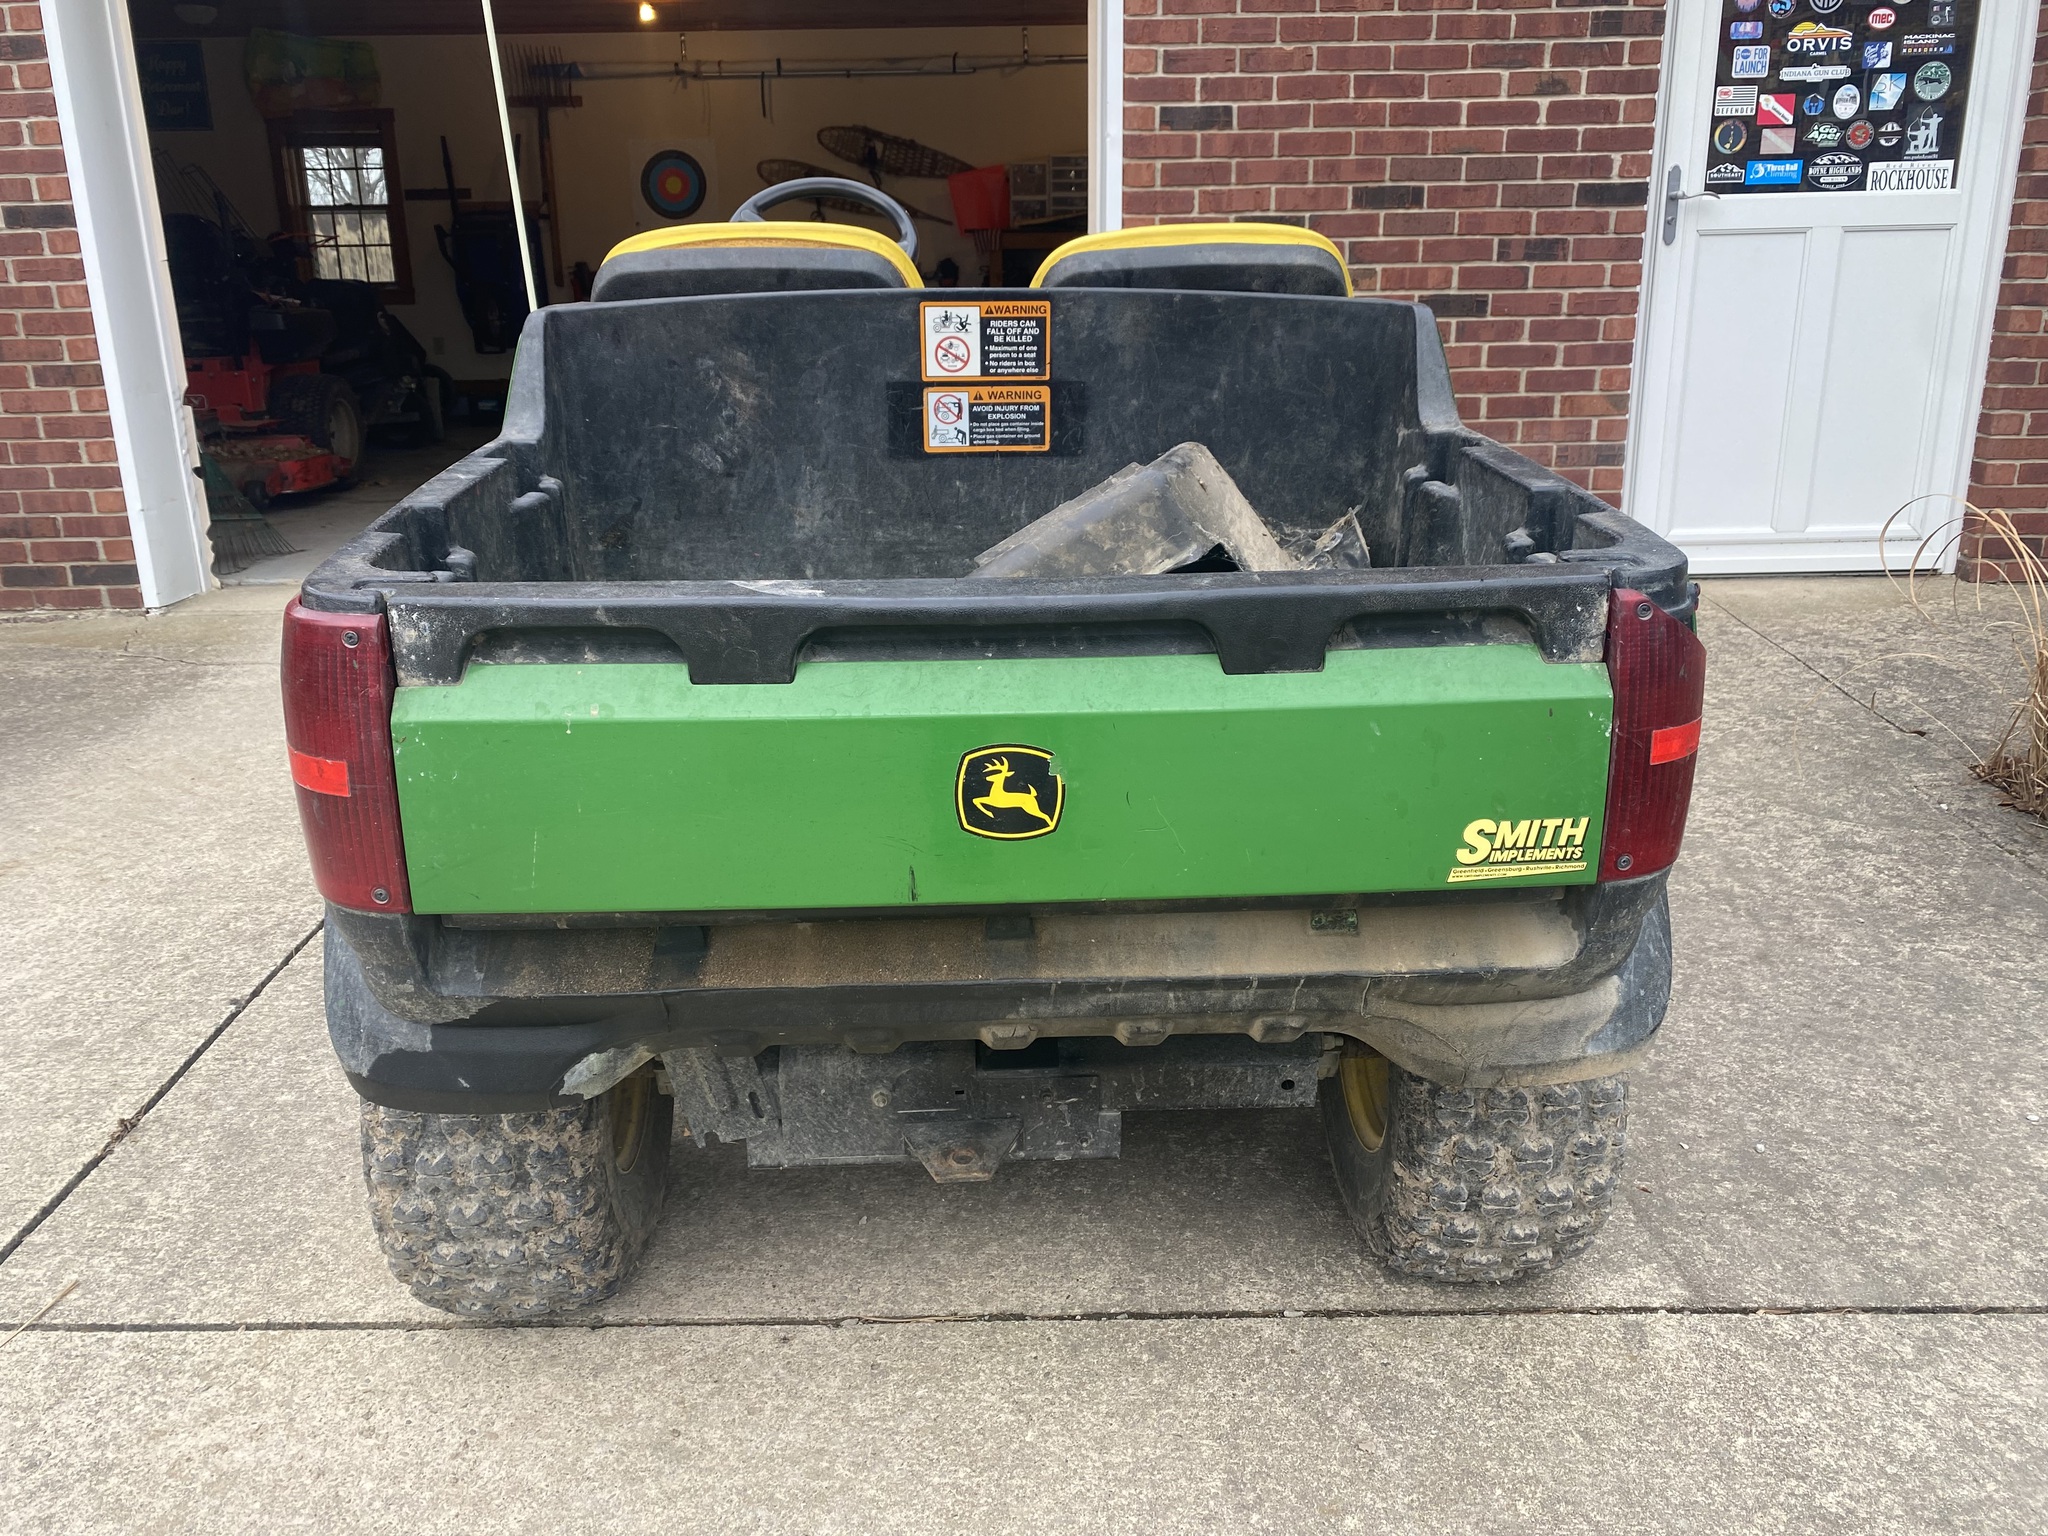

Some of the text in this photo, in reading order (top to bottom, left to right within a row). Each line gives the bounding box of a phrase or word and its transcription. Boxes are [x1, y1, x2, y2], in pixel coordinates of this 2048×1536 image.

[1872, 14, 1893, 24] mec
[1787, 37, 1852, 52] ORVIS
[1754, 48, 1768, 60] FOR
[1734, 61, 1767, 73] LAUNCH
[1819, 125, 1837, 133] Go
[1807, 131, 1841, 141] Ape!
[1809, 166, 1862, 175] BOYNE HIGHLANDS
[1870, 168, 1949, 191] ROCKHOUSE
[994, 305, 1047, 314] WARNING
[988, 391, 1042, 400] WARNING
[1456, 817, 1590, 865] SMITH
[1488, 846, 1584, 863] IMPLEMENTS
